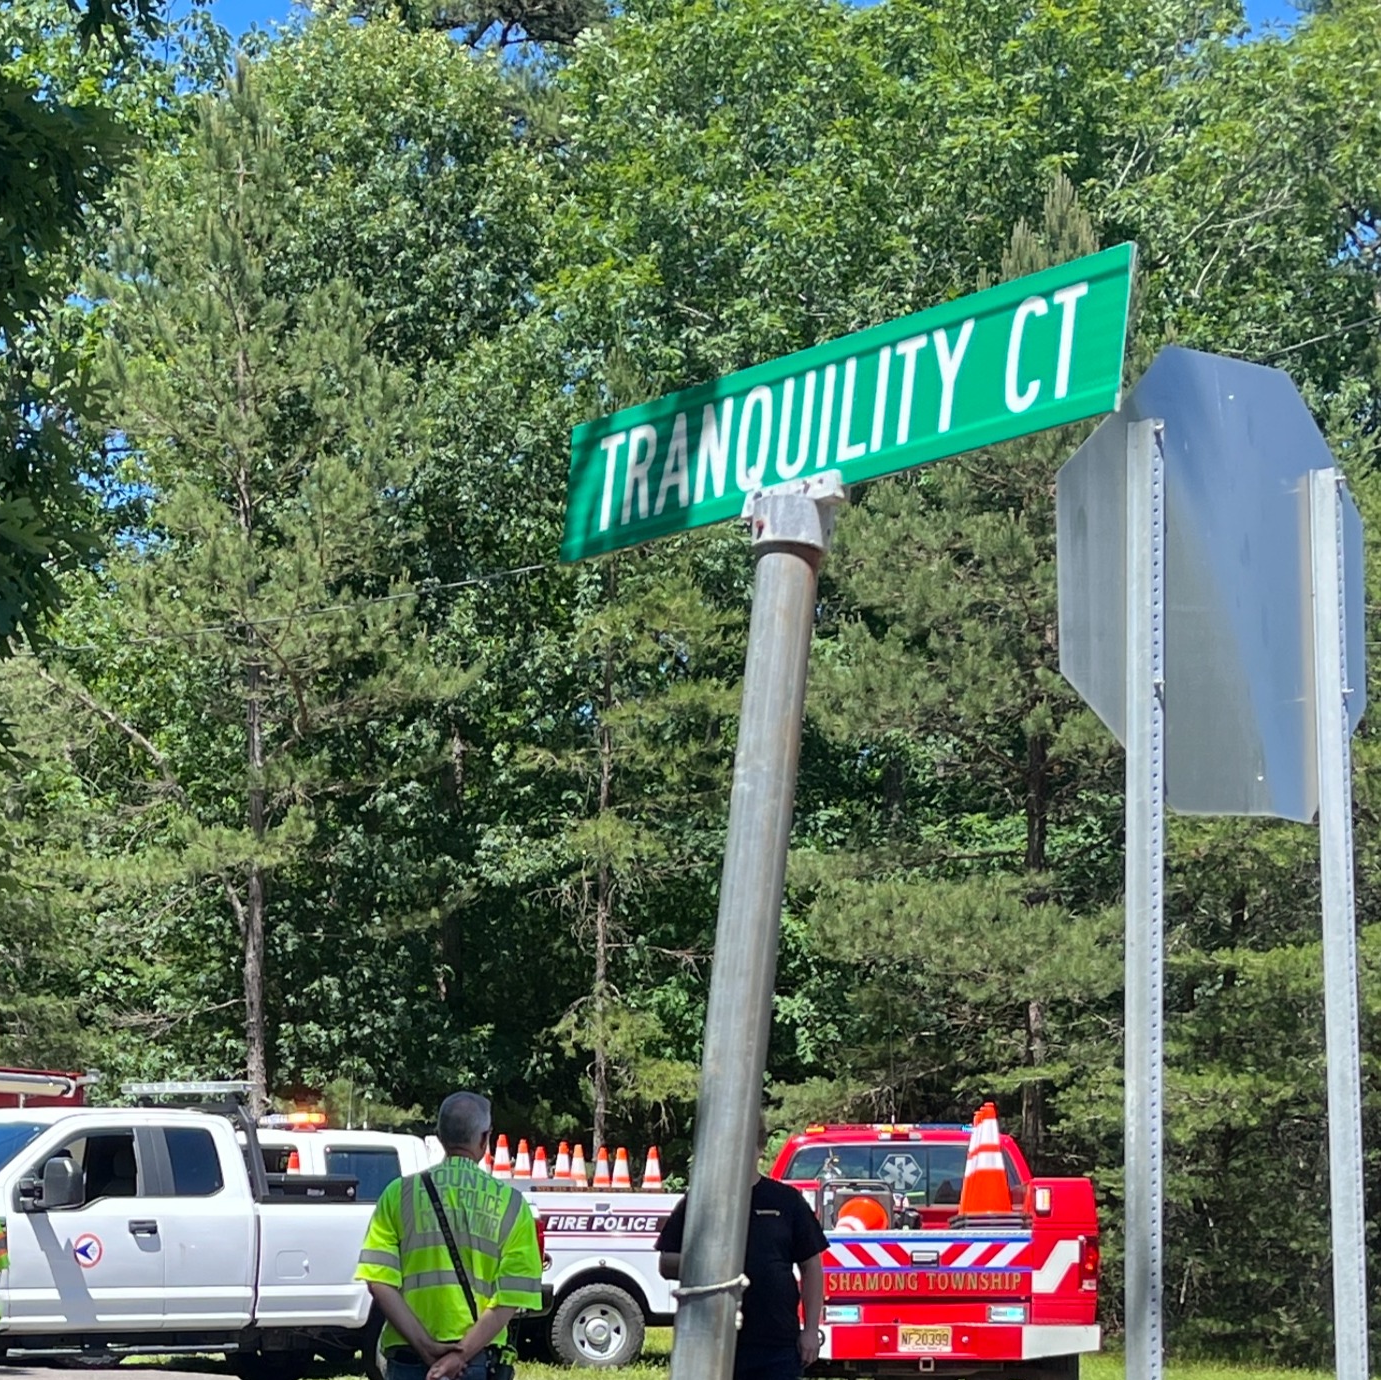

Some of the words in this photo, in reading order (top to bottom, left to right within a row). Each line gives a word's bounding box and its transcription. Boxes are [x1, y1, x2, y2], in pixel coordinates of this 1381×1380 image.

[598, 317, 976, 533] TRANQUILITY
[1003, 282, 1090, 414] CT
[546, 1216, 590, 1230] FIRE
[591, 1216, 659, 1231] POLICE
[828, 1272, 919, 1292] SHAMONG
[926, 1272, 1022, 1292] TOWNSHIP
[901, 1332, 950, 1346] NF20399
